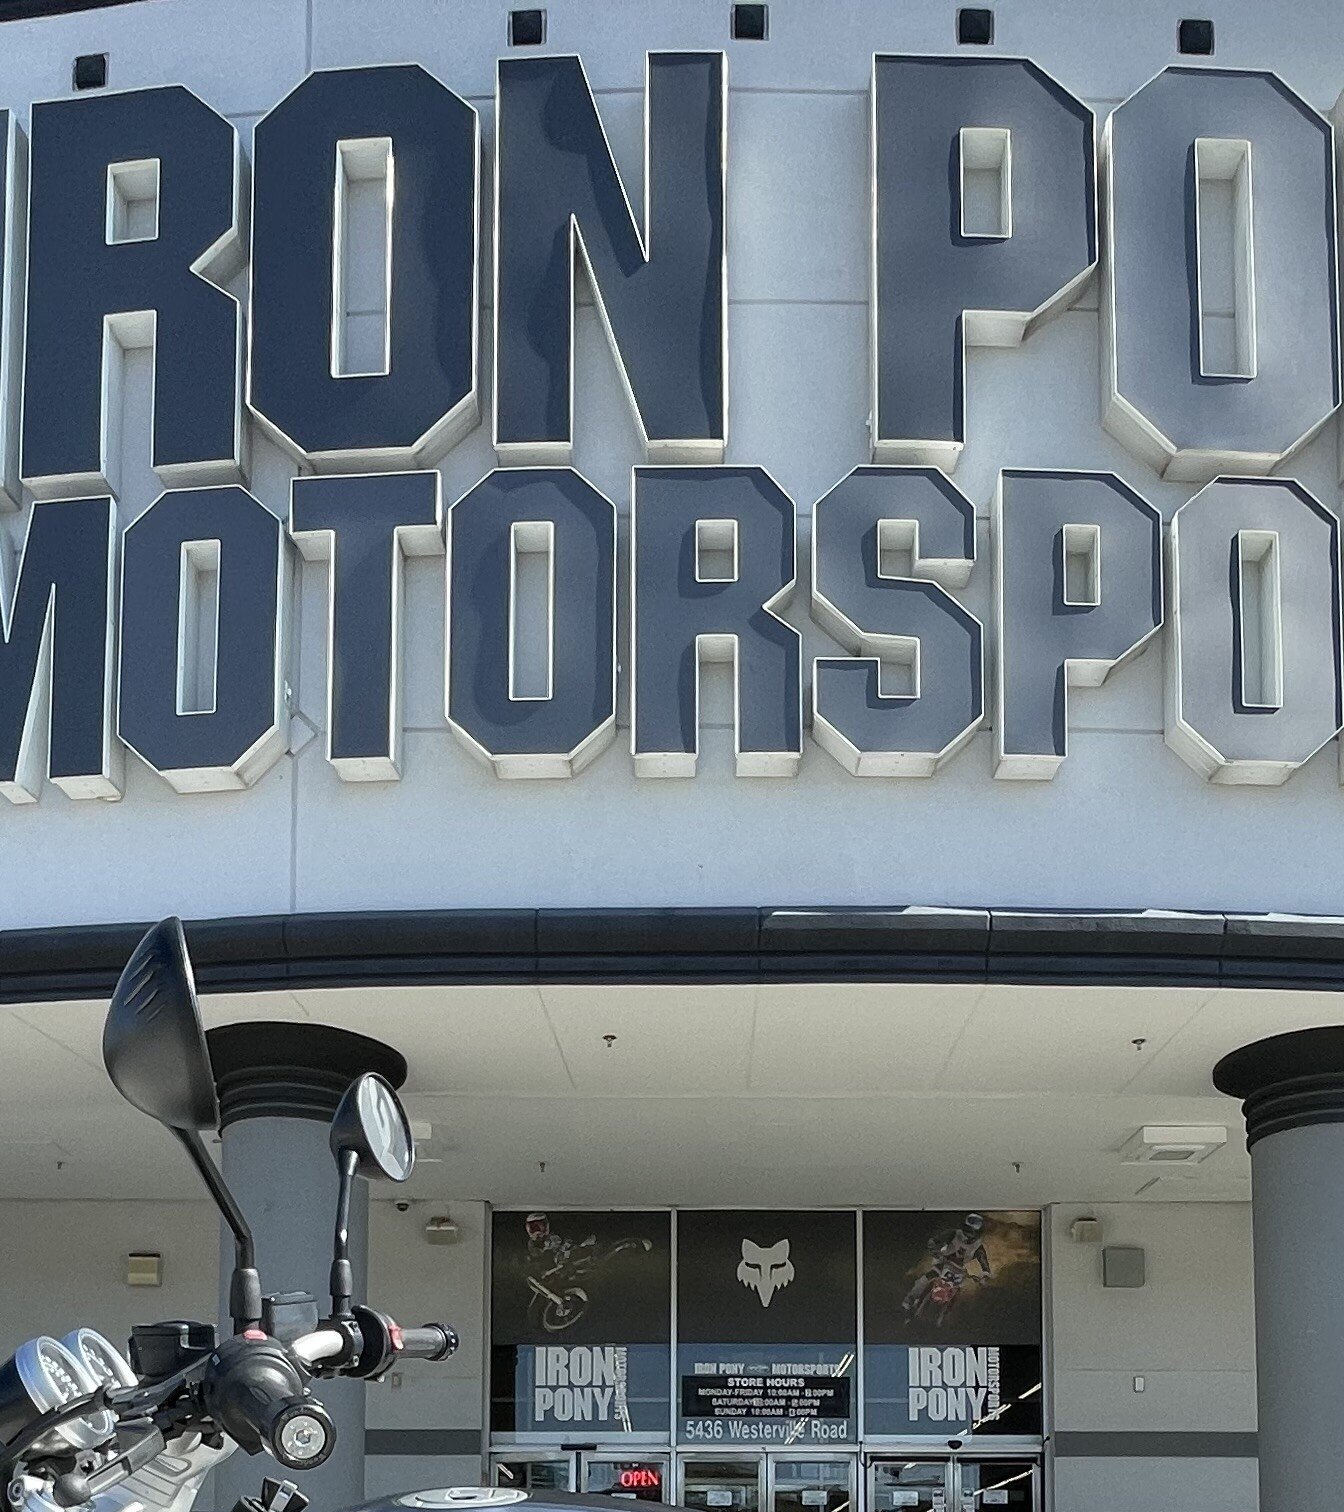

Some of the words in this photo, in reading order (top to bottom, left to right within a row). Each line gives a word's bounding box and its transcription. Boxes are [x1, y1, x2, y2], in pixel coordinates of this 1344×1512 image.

[535, 1347, 614, 1385] IRON
[719, 1363, 744, 1374] PONY
[909, 1347, 987, 1386] IRON
[728, 1378, 763, 1386] STORE
[767, 1378, 805, 1386] HOURS
[535, 1388, 614, 1421] PONY
[909, 1388, 987, 1421] PONY
[686, 1421, 723, 1439] 5436
[811, 1420, 847, 1439] Road
[620, 1470, 659, 1488] OPEN
